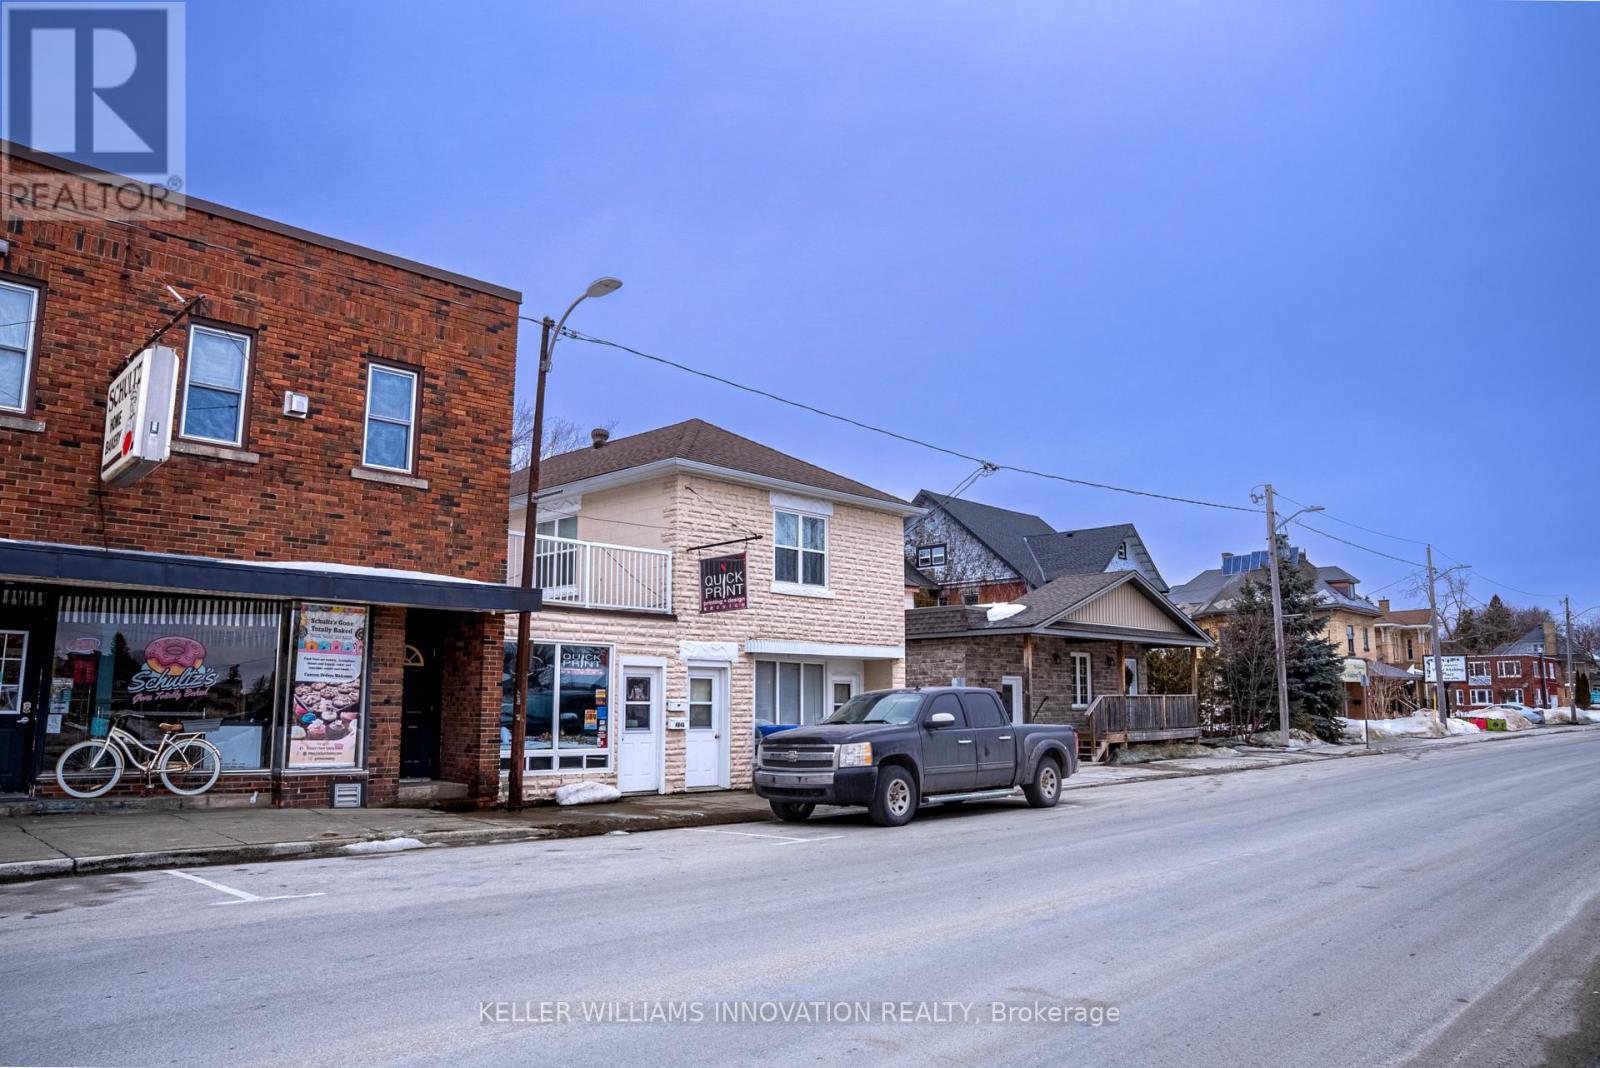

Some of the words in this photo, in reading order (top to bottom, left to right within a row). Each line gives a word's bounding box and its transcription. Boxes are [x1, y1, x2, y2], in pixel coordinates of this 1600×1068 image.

[110, 410, 122, 434] HOME
[704, 571, 744, 588] QUICK
[705, 583, 744, 599] PRINT
[311, 625, 333, 634] Totally
[333, 626, 353, 634] Baked
[562, 652, 601, 661] QUICK
[562, 660, 601, 668] PRINT
[127, 666, 219, 693] Schultz's
